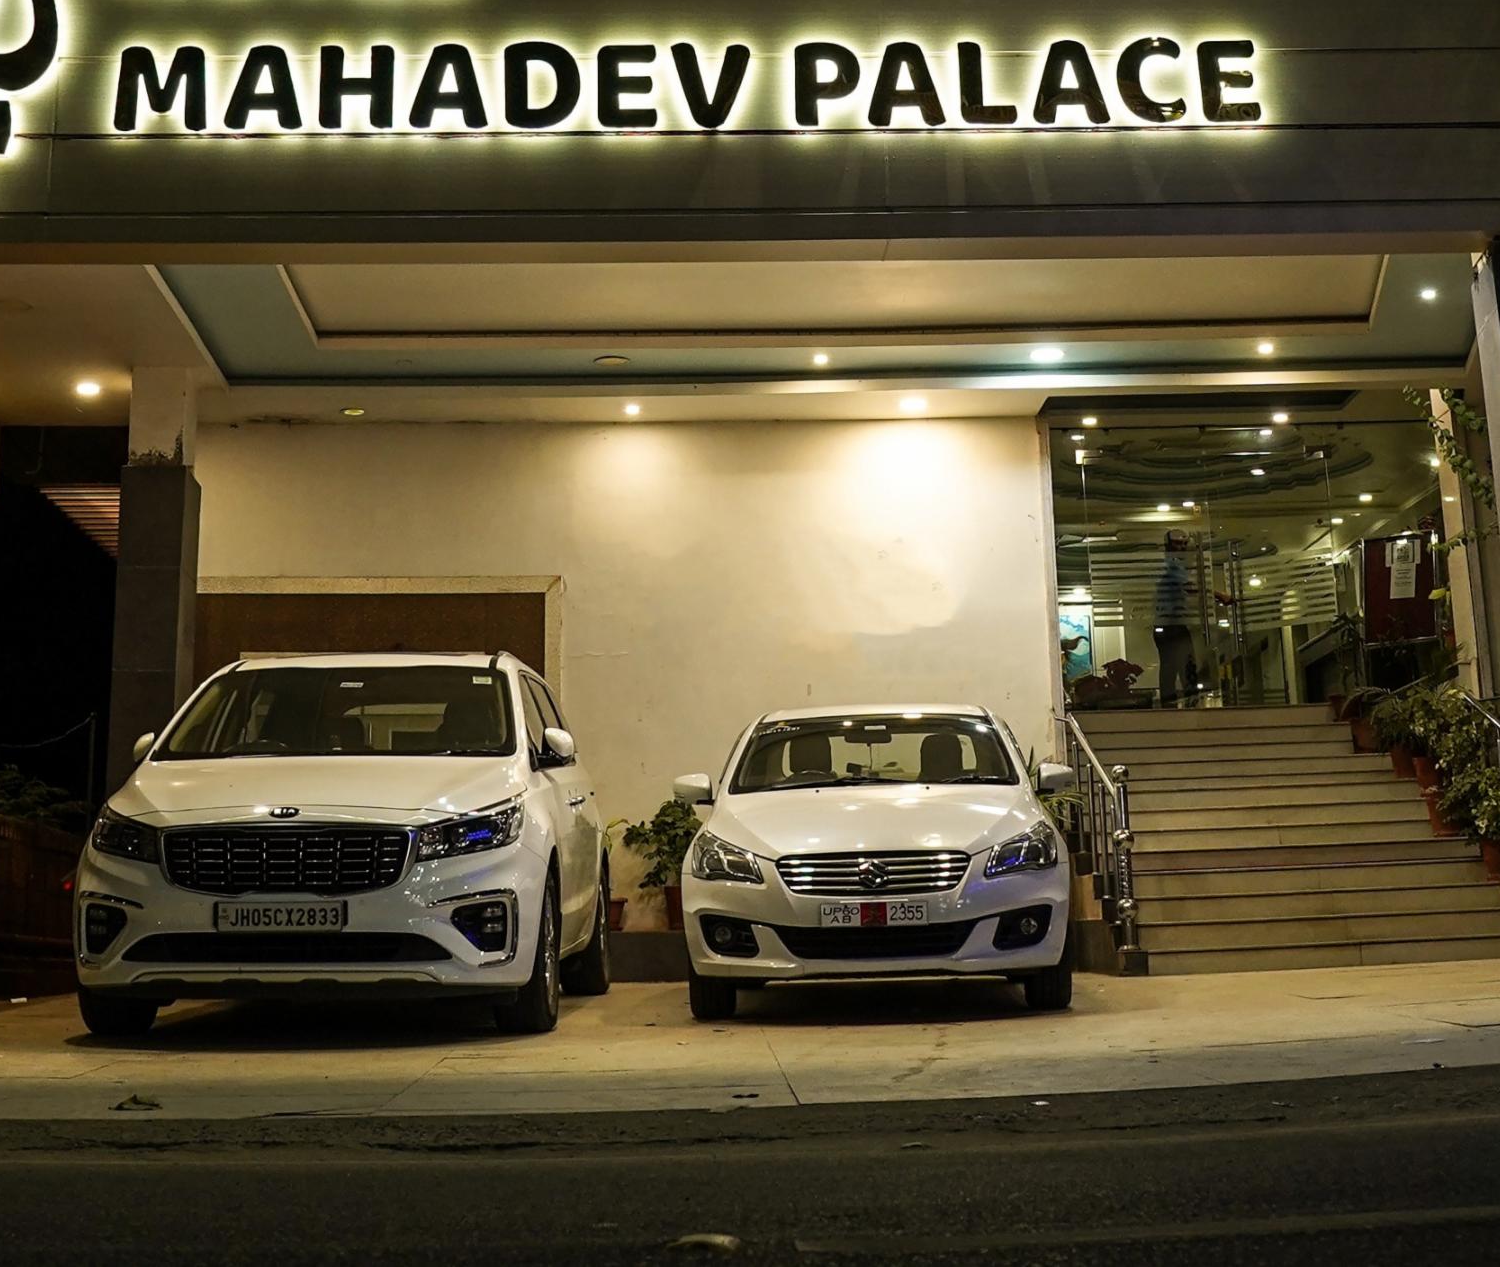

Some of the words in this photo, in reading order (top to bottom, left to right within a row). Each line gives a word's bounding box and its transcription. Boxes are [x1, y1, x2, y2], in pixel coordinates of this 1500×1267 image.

[113, 39, 752, 133] MAHADEV
[791, 35, 1263, 127] PALACE
[229, 907, 339, 927] JH05CX2833
[889, 905, 924, 921] 2355
